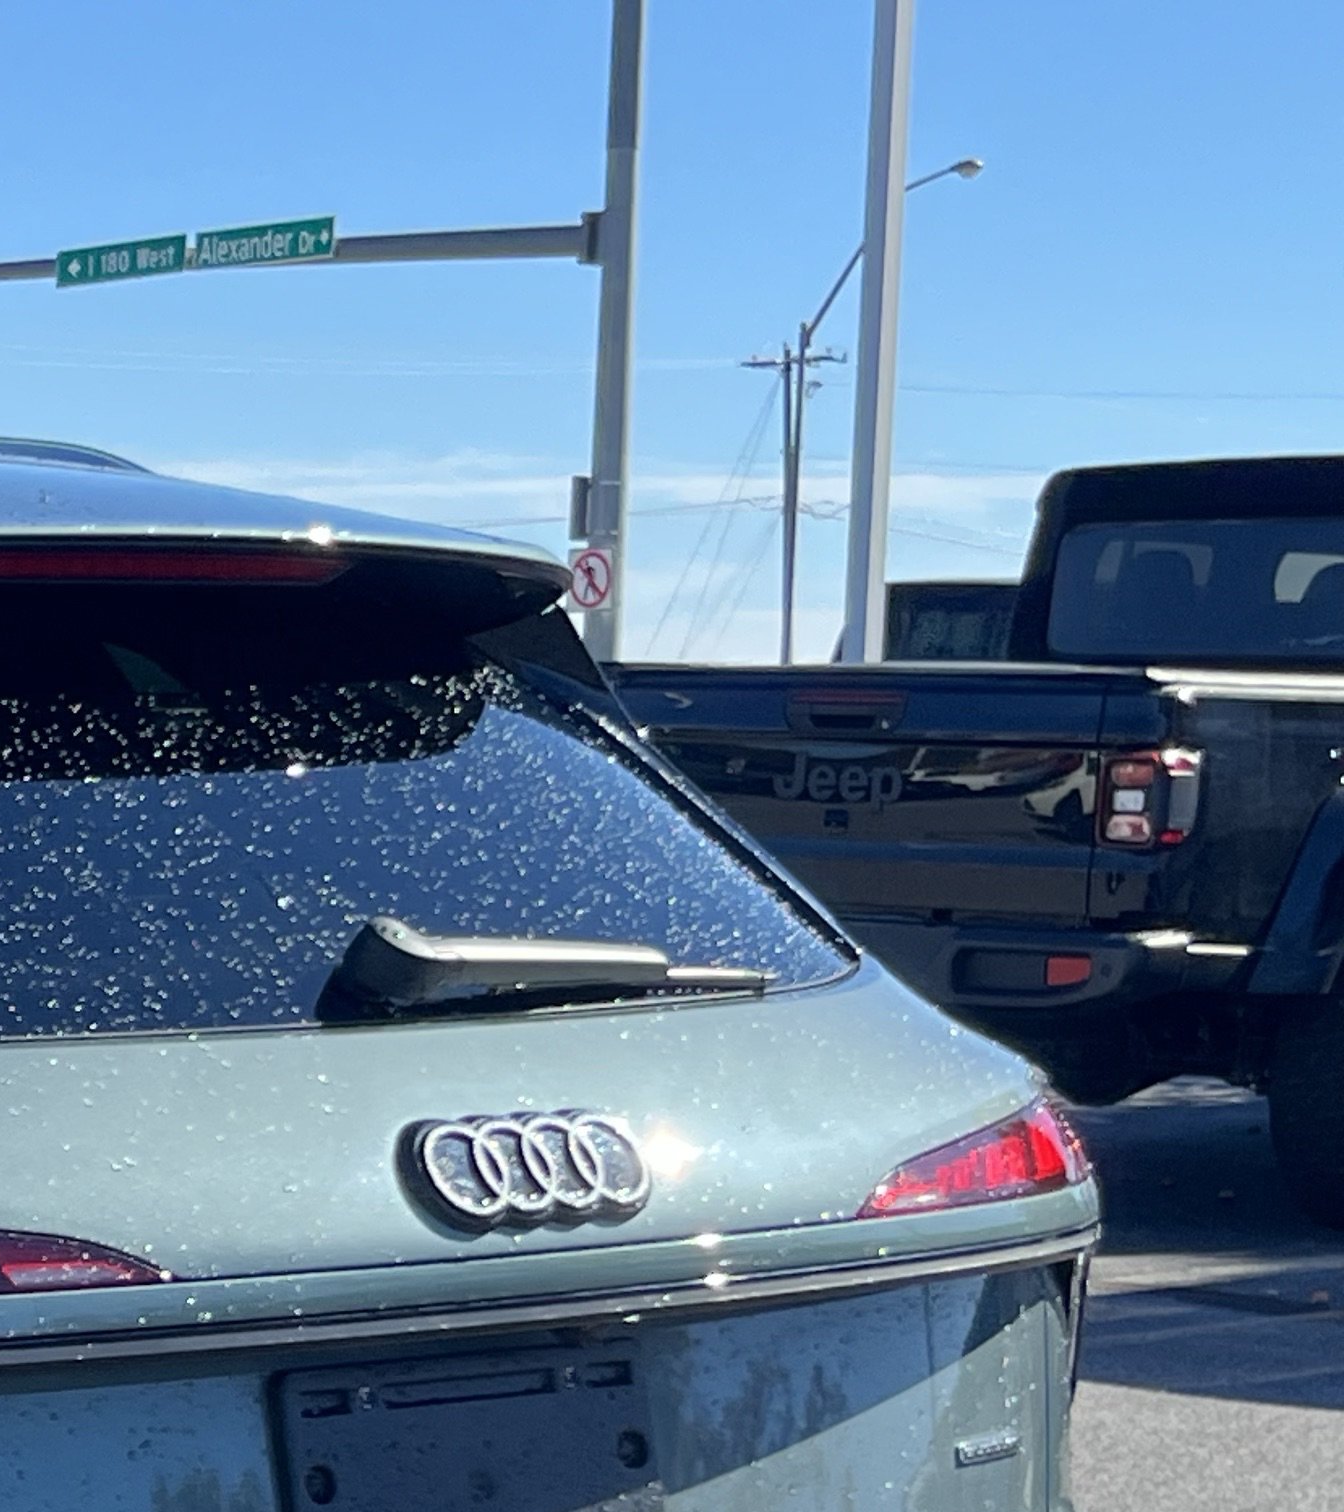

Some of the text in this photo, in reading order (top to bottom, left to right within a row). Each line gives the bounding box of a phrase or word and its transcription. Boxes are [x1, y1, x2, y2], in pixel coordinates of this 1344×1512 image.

[101, 253, 130, 275] 180
[136, 245, 175, 270] West
[197, 230, 317, 265] Alexander Dr
[772, 751, 903, 814] Jeep
